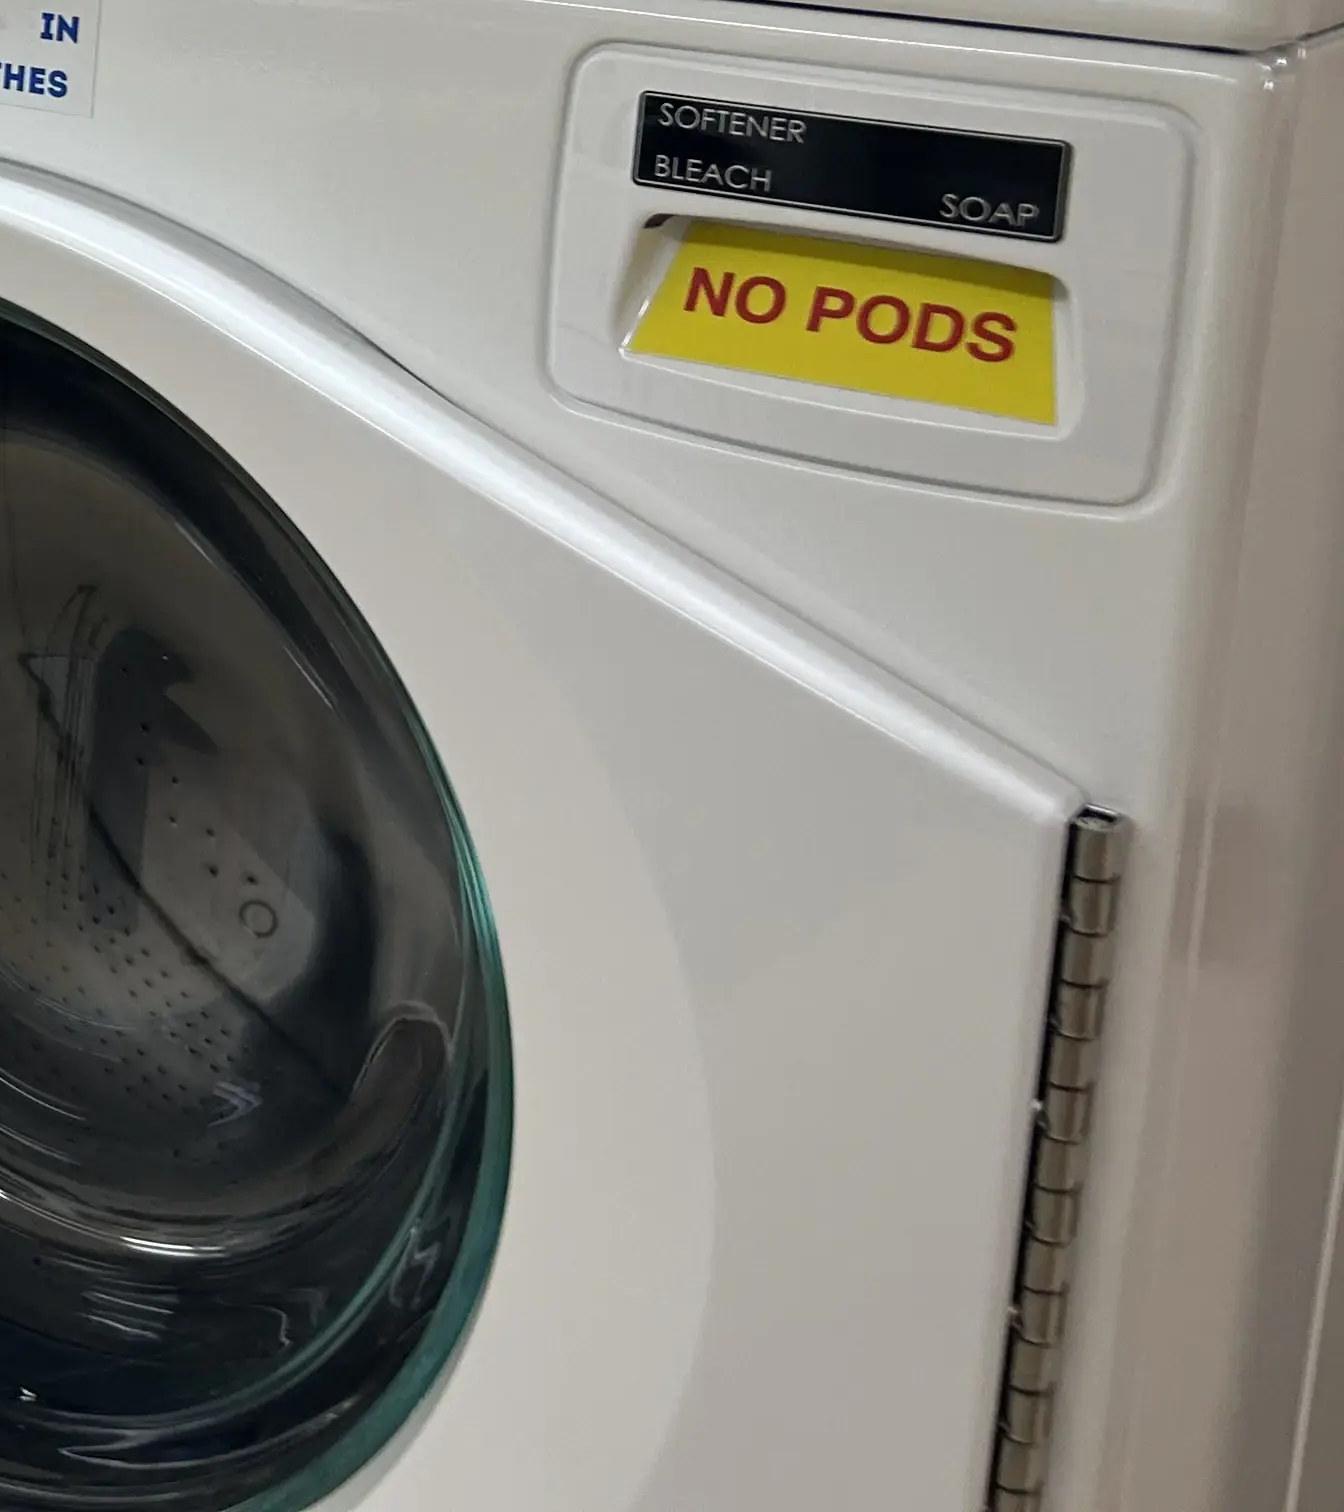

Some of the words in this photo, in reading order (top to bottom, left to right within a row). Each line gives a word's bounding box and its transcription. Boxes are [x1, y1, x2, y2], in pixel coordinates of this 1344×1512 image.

[40, 12, 80, 44] IN
[657, 102, 807, 144] SOFTENER
[654, 154, 772, 192] BLEACH
[940, 193, 1041, 227] SOAP
[683, 266, 788, 324] NO
[806, 285, 1018, 364] PODS
